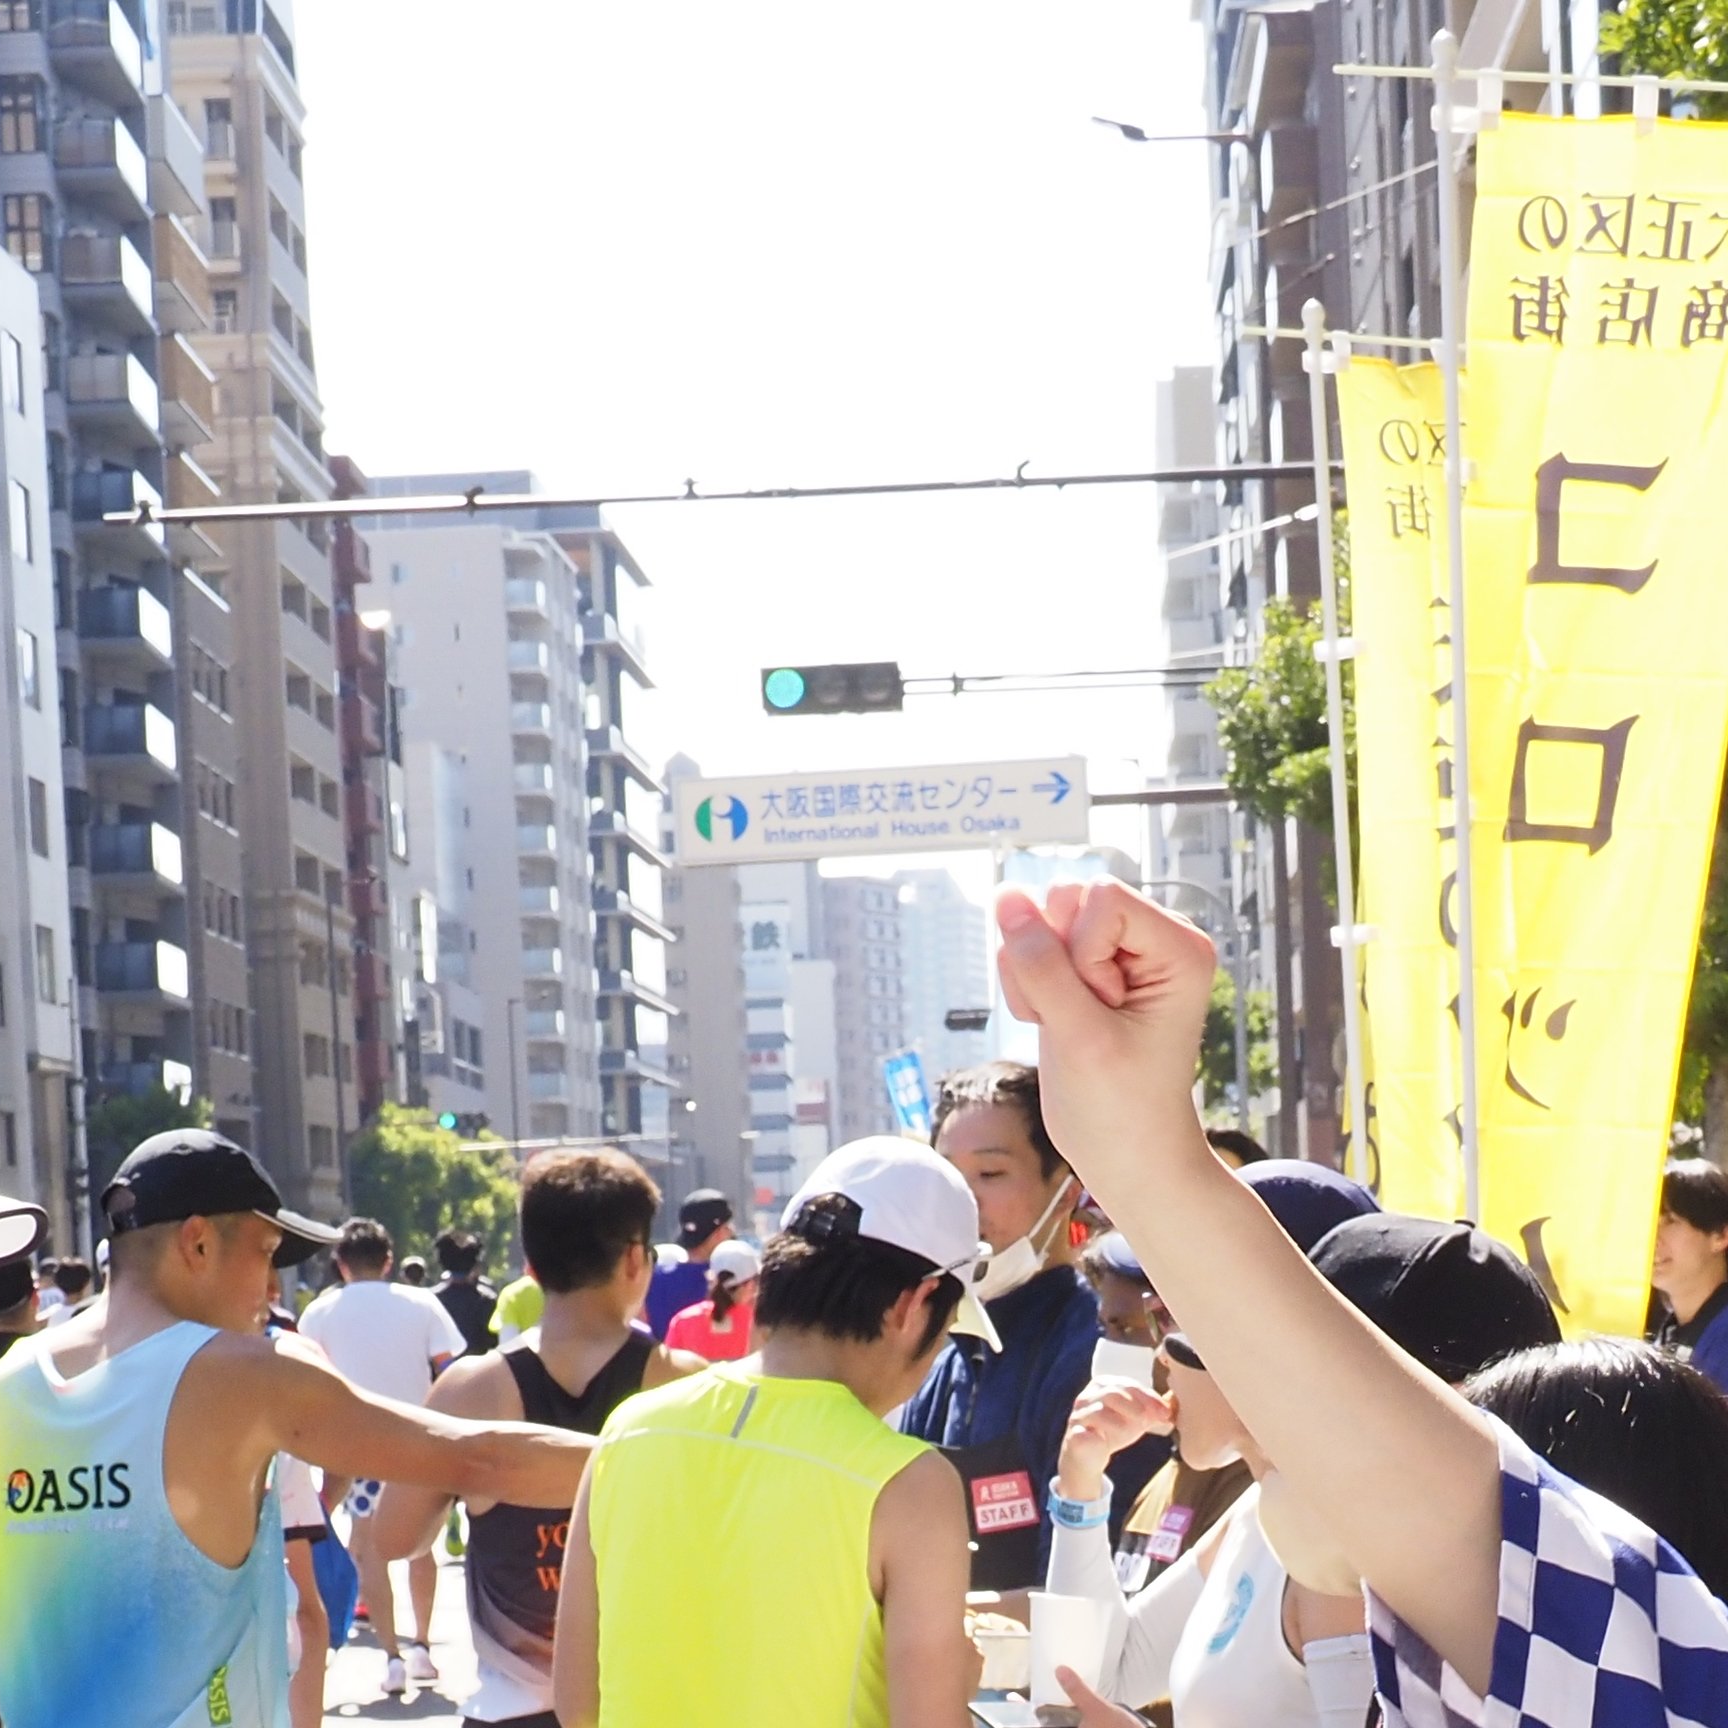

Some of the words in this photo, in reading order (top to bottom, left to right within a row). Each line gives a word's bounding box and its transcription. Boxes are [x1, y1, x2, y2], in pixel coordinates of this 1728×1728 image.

[761, 776, 1018, 820] 大阪国際交流センター
[763, 822, 880, 844] International
[890, 818, 951, 836] House
[960, 814, 1021, 833] Osaka
[7, 1462, 131, 1513] OASIS
[980, 1503, 1029, 1523] STAFF
